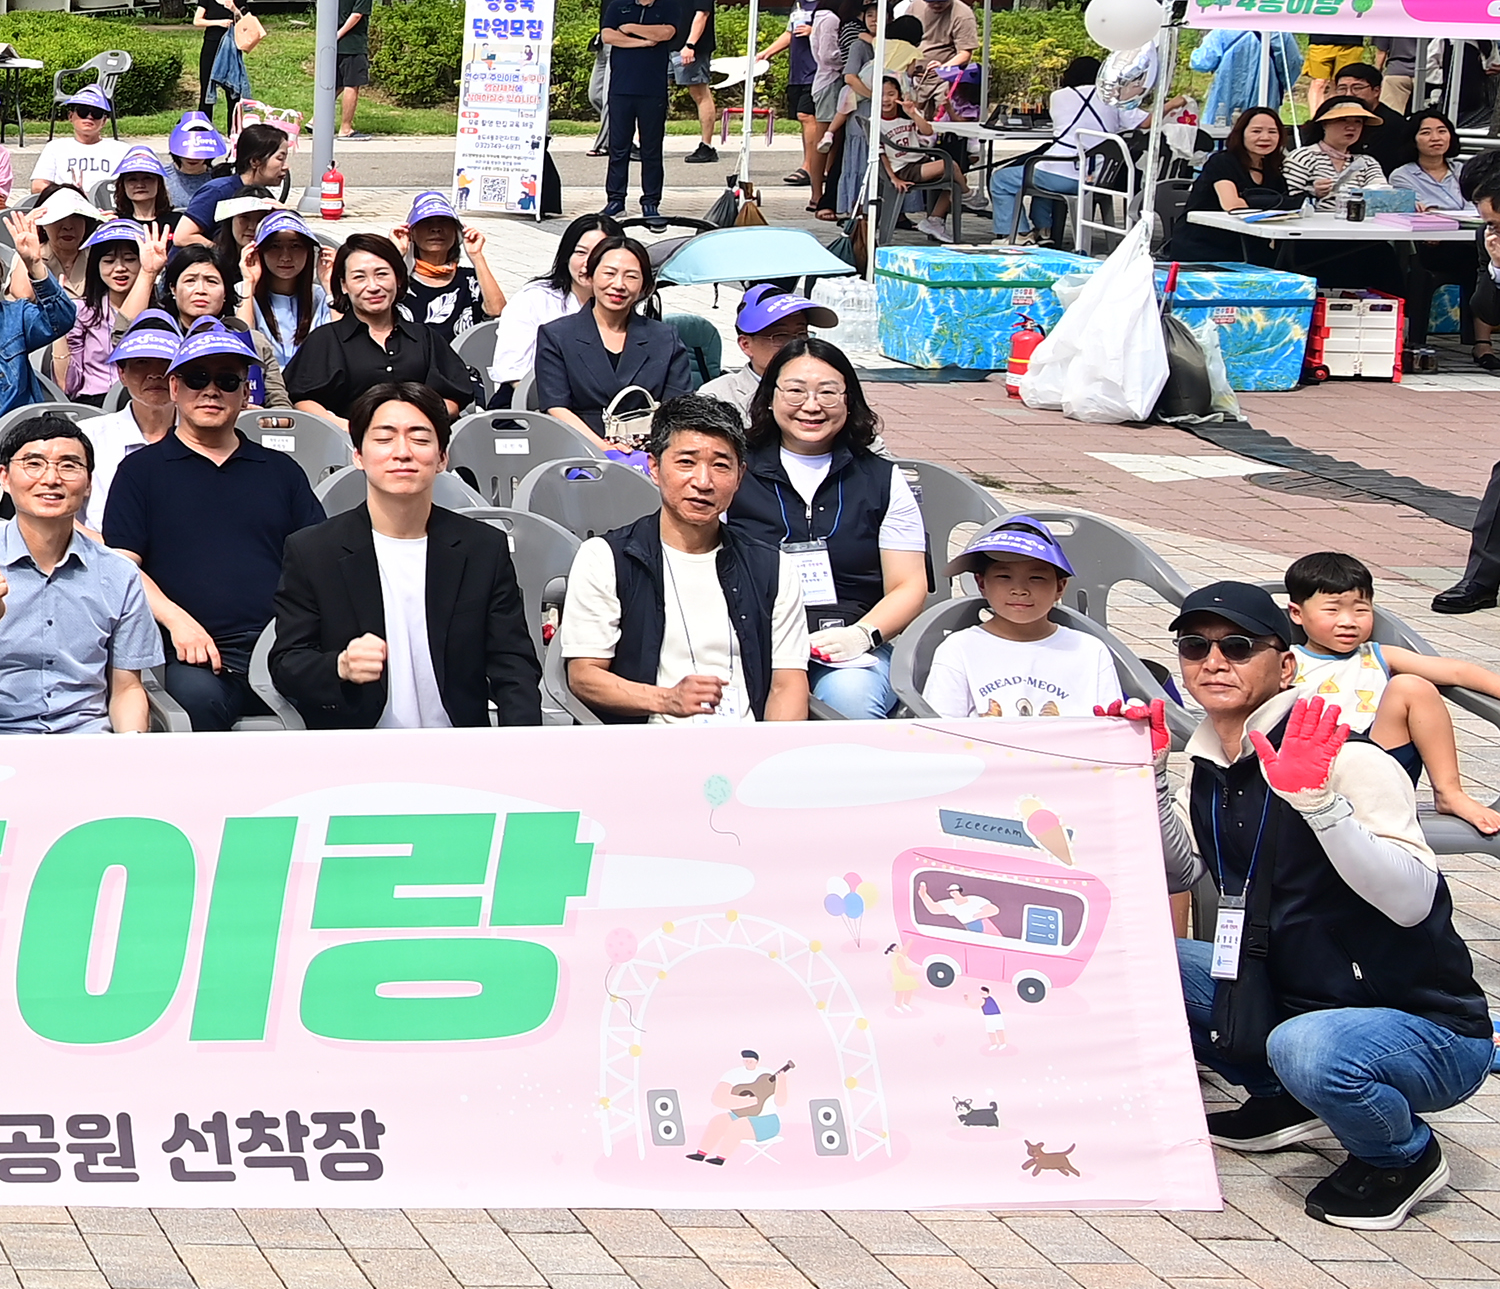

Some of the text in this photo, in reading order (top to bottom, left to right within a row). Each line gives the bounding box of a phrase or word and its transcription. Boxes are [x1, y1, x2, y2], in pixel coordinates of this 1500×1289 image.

[472, 18, 544, 40] 단원모집
[68, 158, 110, 172] POLO
[978, 676, 1069, 700] BREAD-MEOW
[956, 817, 1023, 839] Icecream
[161, 1107, 387, 1184] 선착장
